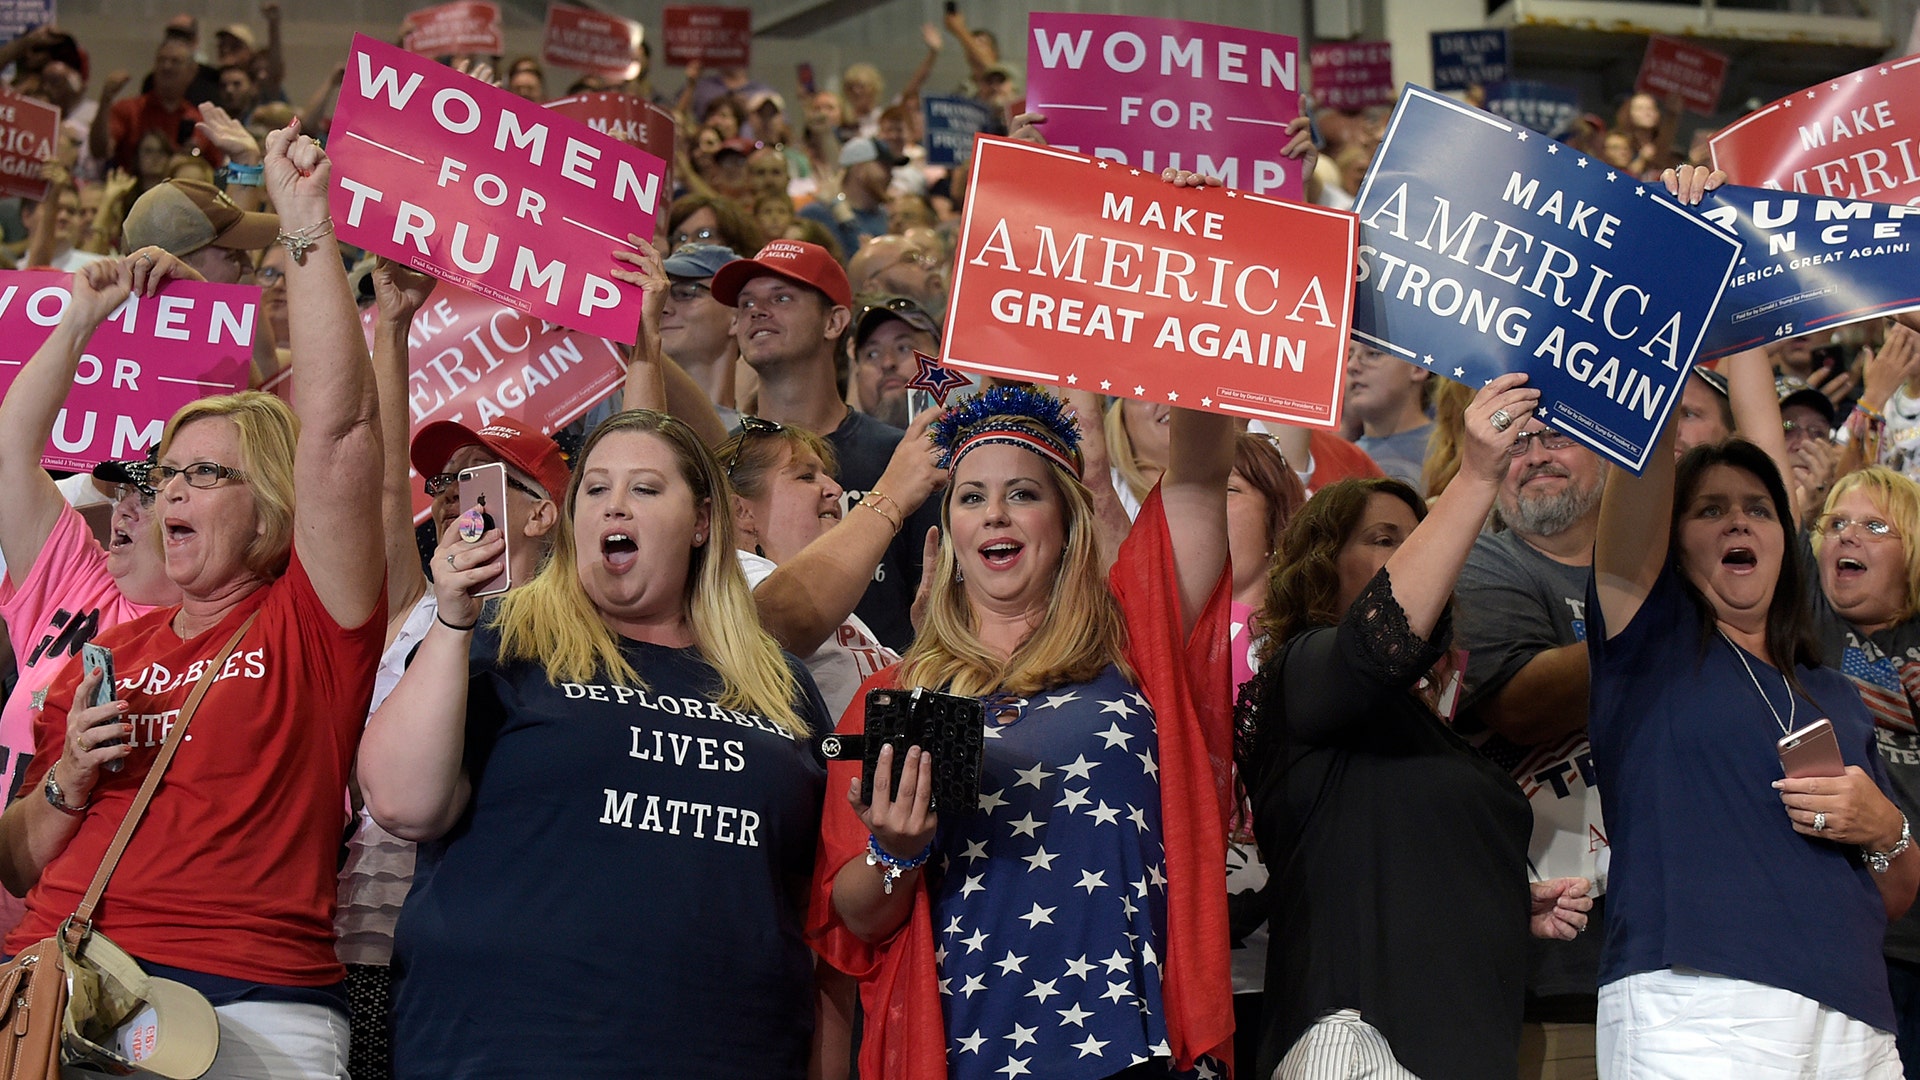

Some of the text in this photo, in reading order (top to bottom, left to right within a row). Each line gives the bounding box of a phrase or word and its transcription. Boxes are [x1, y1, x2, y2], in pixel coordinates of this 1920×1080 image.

[1033, 28, 1295, 91] WOMEN
[357, 51, 659, 215] WOMEN
[1120, 97, 1213, 131] FOR
[1798, 101, 1895, 151] MAKE
[437, 156, 547, 226] FOR
[1102, 192, 1224, 240] MAKE
[1501, 171, 1621, 249] MAKE
[1701, 199, 1920, 236] RUMP
[340, 177, 621, 317] TRUMP
[1730, 243, 1910, 289] MERICA GREAT AGAIN!
[1738, 222, 1901, 265] NCE
[413, 258, 425, 269] Paid
[434, 266, 441, 275] by
[442, 269, 461, 282] Donald
[466, 279, 483, 292] Trump
[484, 285, 492, 294] for
[969, 217, 1336, 328] AMERICA
[1356, 244, 1532, 346] STRONG
[1362, 182, 1682, 372] AMERICA
[0, 286, 256, 347] OMEN
[990, 289, 1306, 373] GREAT AGAIN
[1759, 304, 1775, 312] Donald
[1778, 298, 1793, 306] Trump
[1775, 323, 1793, 337] 45
[74, 354, 141, 391] OR
[409, 307, 550, 424] ERIC
[476, 337, 583, 427] AGAIN
[1533, 325, 1666, 421] AGAIN
[1247, 393, 1263, 401] Donald
[1268, 396, 1283, 405] Trump
[1578, 414, 1592, 426] Donald
[1594, 424, 1607, 436] Trump
[68, 460, 85, 469] Trump
[629, 726, 745, 772] LIVES
[599, 788, 760, 847] MATTER
